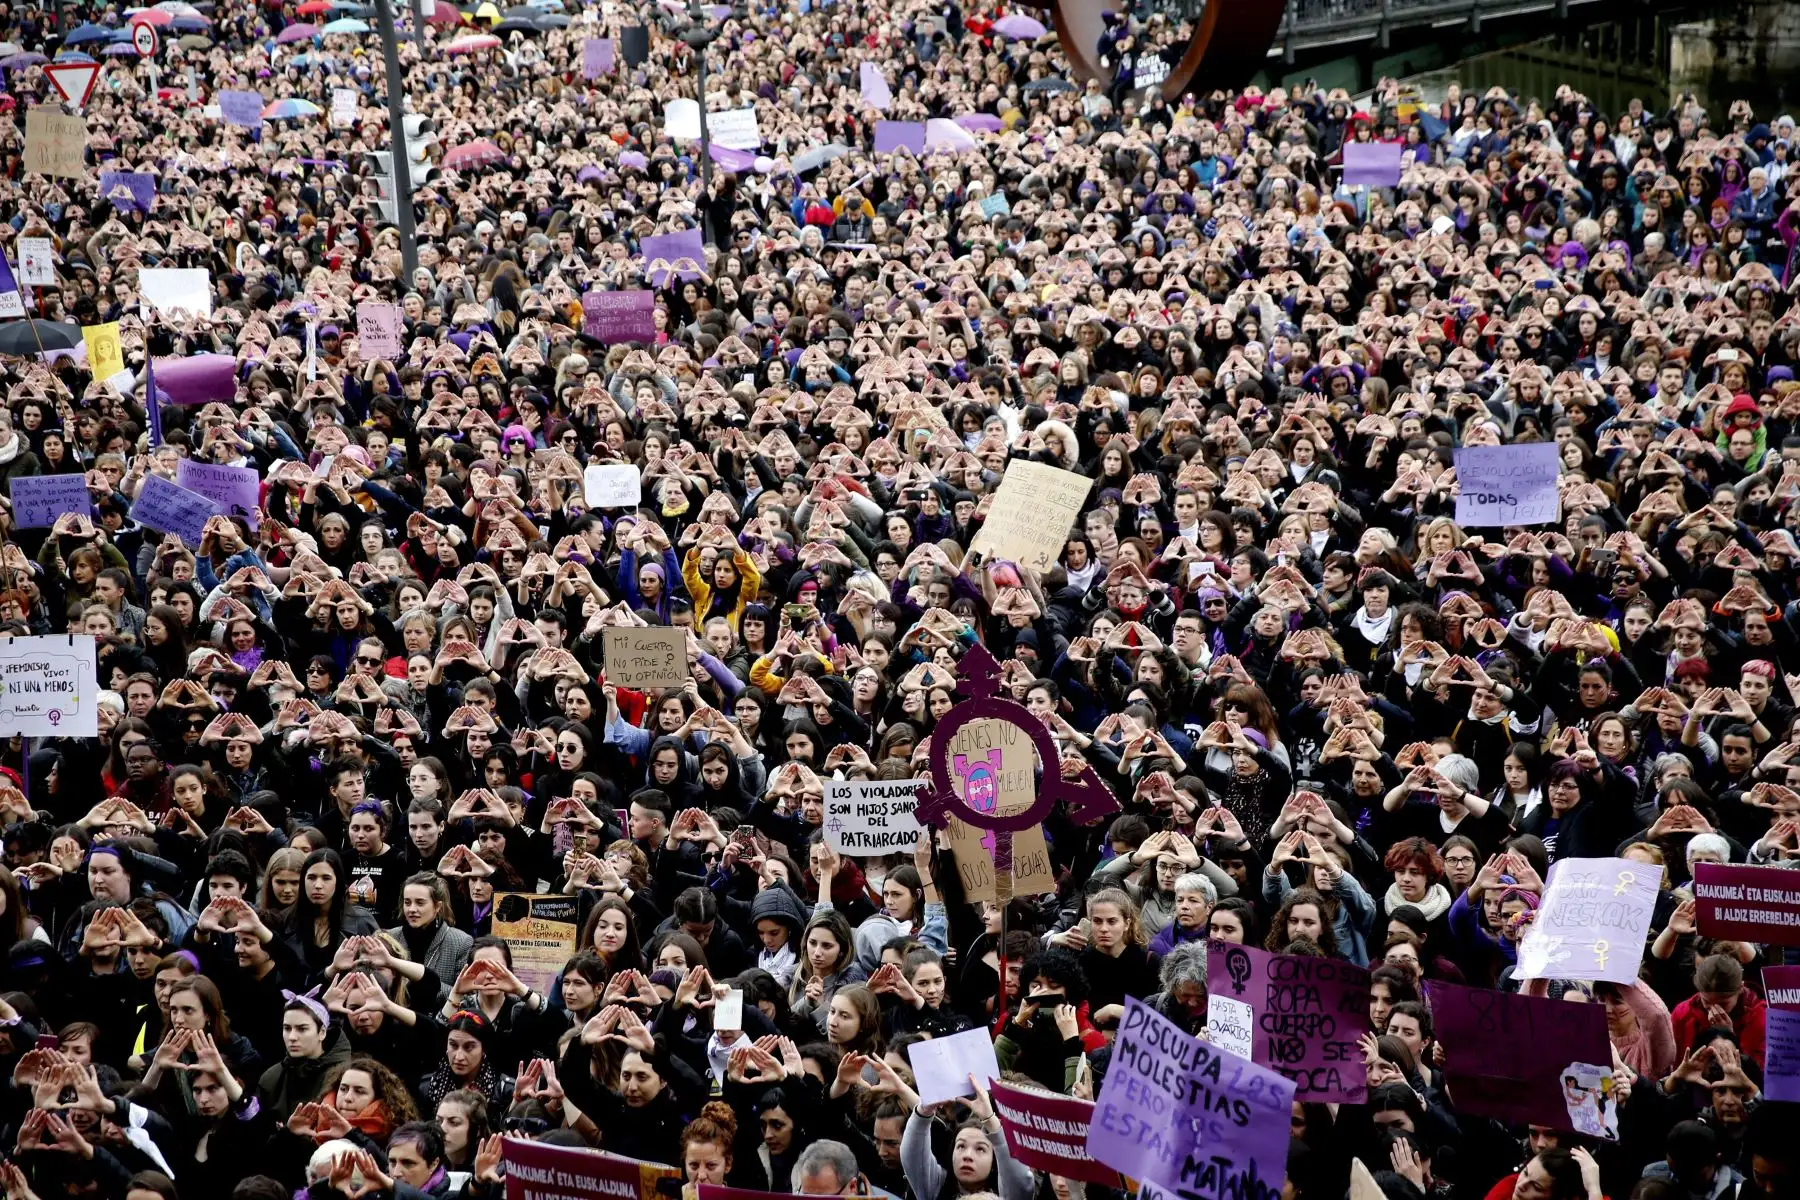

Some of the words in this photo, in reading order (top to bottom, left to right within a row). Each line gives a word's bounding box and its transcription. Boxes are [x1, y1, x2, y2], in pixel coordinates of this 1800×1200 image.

[1463, 493, 1518, 506] TODAS
[617, 672, 631, 682] TU
[9, 681, 21, 693] NI
[24, 680, 41, 693] UNA
[44, 681, 74, 693] MENOS
[833, 787, 852, 798] LOS
[860, 784, 926, 798] VIOLADOR
[829, 804, 851, 814] SON
[857, 802, 888, 816] HIJOS
[891, 801, 920, 815] SANO
[868, 817, 888, 826] DEL
[841, 830, 918, 848] PATRIARCADO
[962, 861, 989, 890] SUS
[1747, 888, 1762, 902] ETA
[1763, 889, 1800, 905] EUSKALD
[1551, 901, 1644, 932] NESKAK
[1715, 907, 1722, 920] BI
[1724, 908, 1748, 922] ALDIZ
[1267, 957, 1310, 981] CON
[1267, 984, 1323, 1012] ROPA
[1768, 989, 1800, 1004] EMAKU
[1211, 998, 1237, 1014] HASTA
[1209, 1019, 1251, 1043] OVARIOS
[1260, 1013, 1336, 1039] CUERPO
[1124, 1004, 1221, 1085] DISCULPA
[1323, 1042, 1353, 1061] SE
[1118, 1037, 1251, 1127] MOLESTIAS
[1112, 1069, 1166, 1115] PERO
[1032, 1114, 1048, 1132] ETA
[1021, 1133, 1043, 1151] ALDIZ
[557, 1173, 575, 1187] ETA
